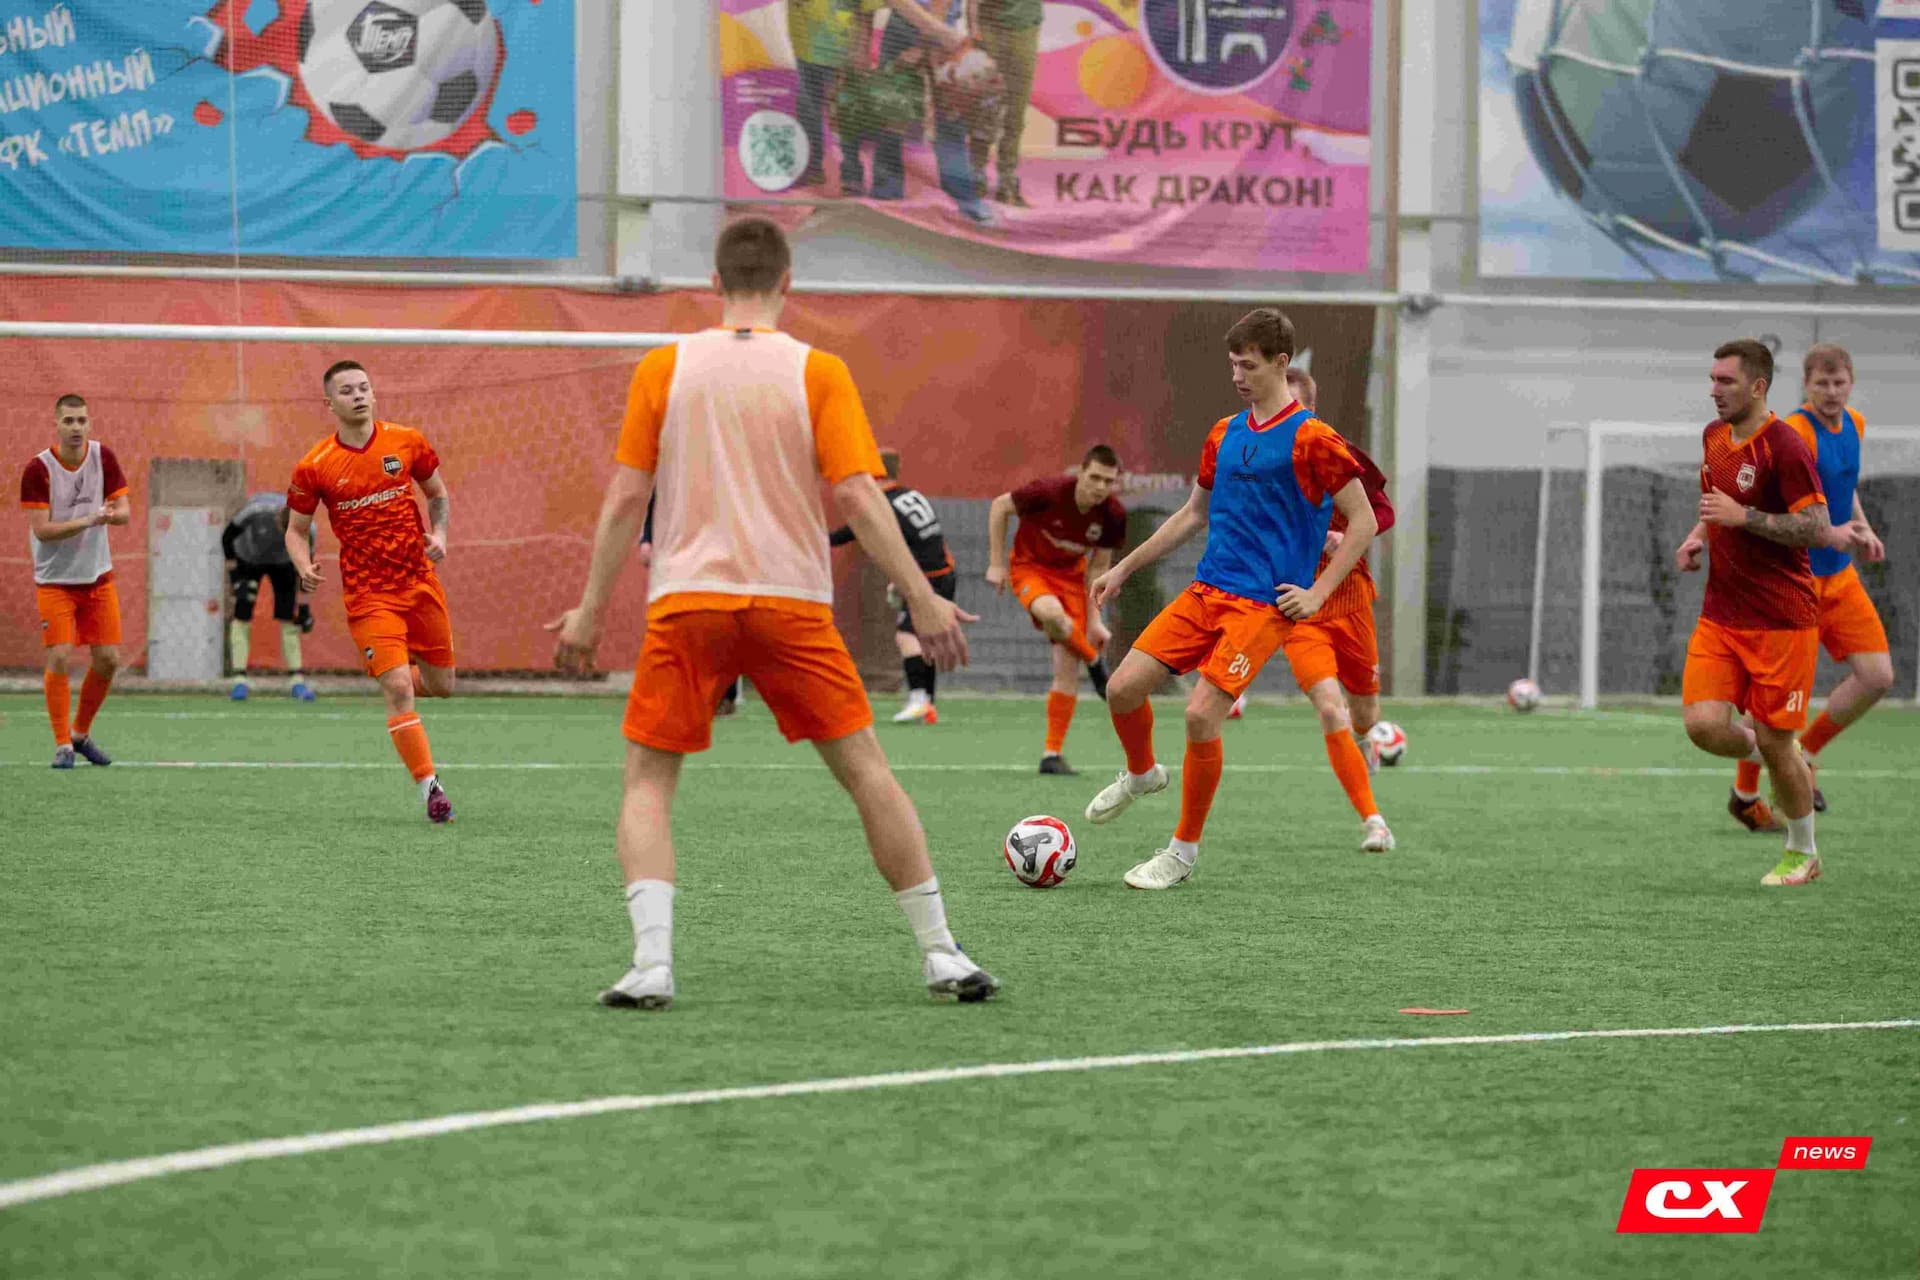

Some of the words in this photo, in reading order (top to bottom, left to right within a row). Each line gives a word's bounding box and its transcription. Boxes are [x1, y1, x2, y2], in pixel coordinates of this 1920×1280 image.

[58, 109, 175, 158] «ТЕМП»
[1056, 117, 1187, 155] БУДЬ
[1202, 121, 1312, 158] КРУТ,
[1055, 173, 1137, 202] КАК
[1151, 176, 1333, 208] ДРАКОН!
[1228, 653, 1250, 679] 24
[1786, 690, 1804, 712] 21
